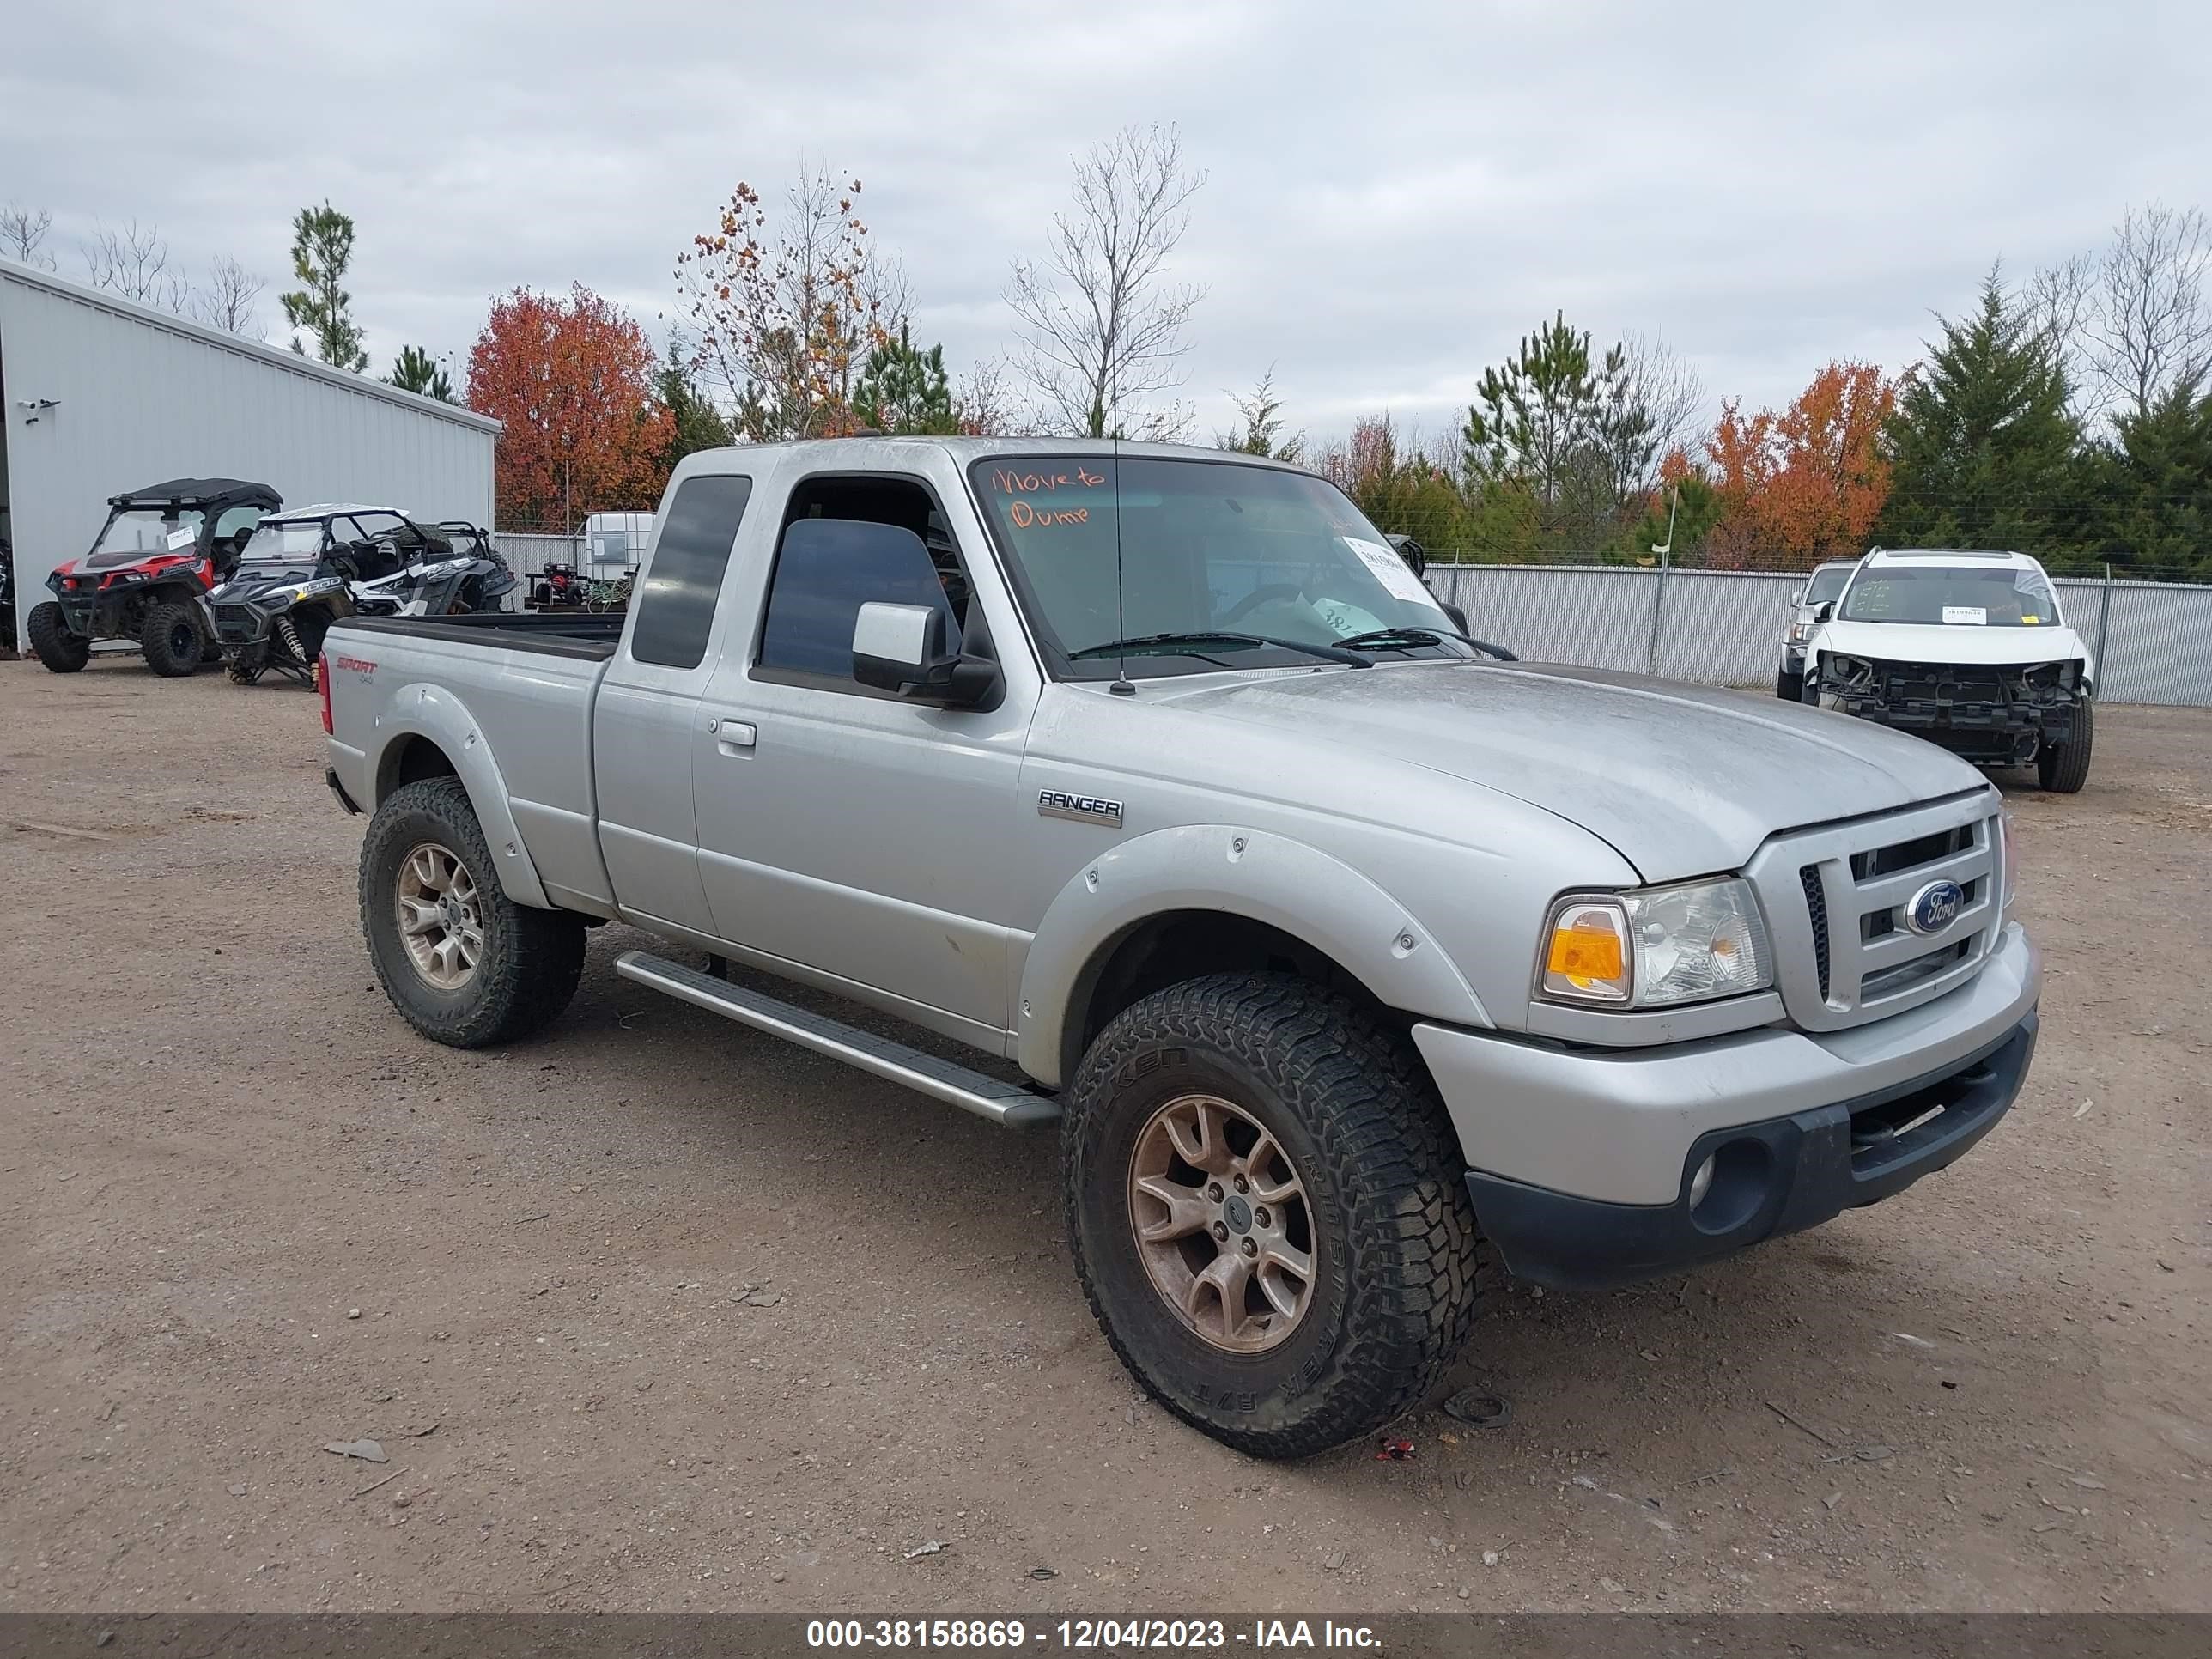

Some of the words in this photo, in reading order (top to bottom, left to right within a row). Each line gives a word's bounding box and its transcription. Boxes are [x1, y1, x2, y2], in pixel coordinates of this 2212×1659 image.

[992, 467, 1076, 495] Move
[1078, 466, 1106, 488] to
[302, 578, 341, 592] 1000
[380, 579, 404, 595] XP
[336, 656, 379, 674] SPORT
[1039, 791, 1121, 817] RANGER
[1927, 888, 1957, 924] Ford
